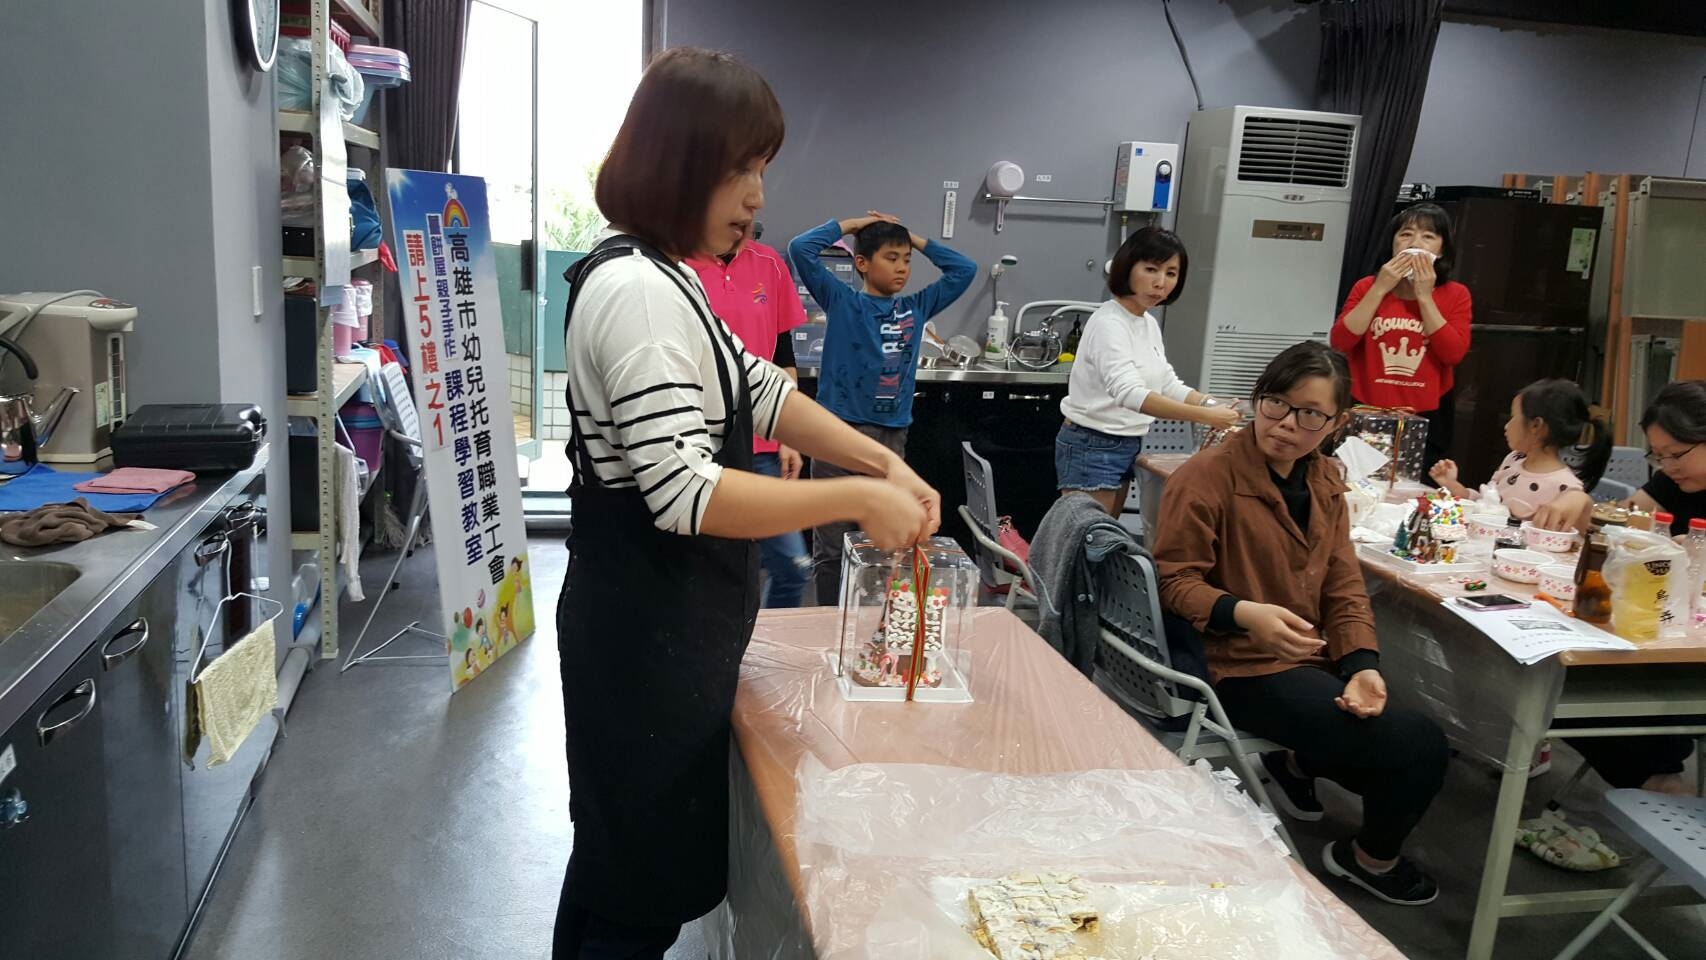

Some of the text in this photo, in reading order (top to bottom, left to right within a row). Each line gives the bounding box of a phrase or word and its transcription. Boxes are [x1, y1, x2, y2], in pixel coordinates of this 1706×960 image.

[406, 233, 445, 447] 請上5樓之1
[448, 231, 505, 586] 高雄市幼兒托育職業工會
[444, 368, 484, 567] 課程學習教室
